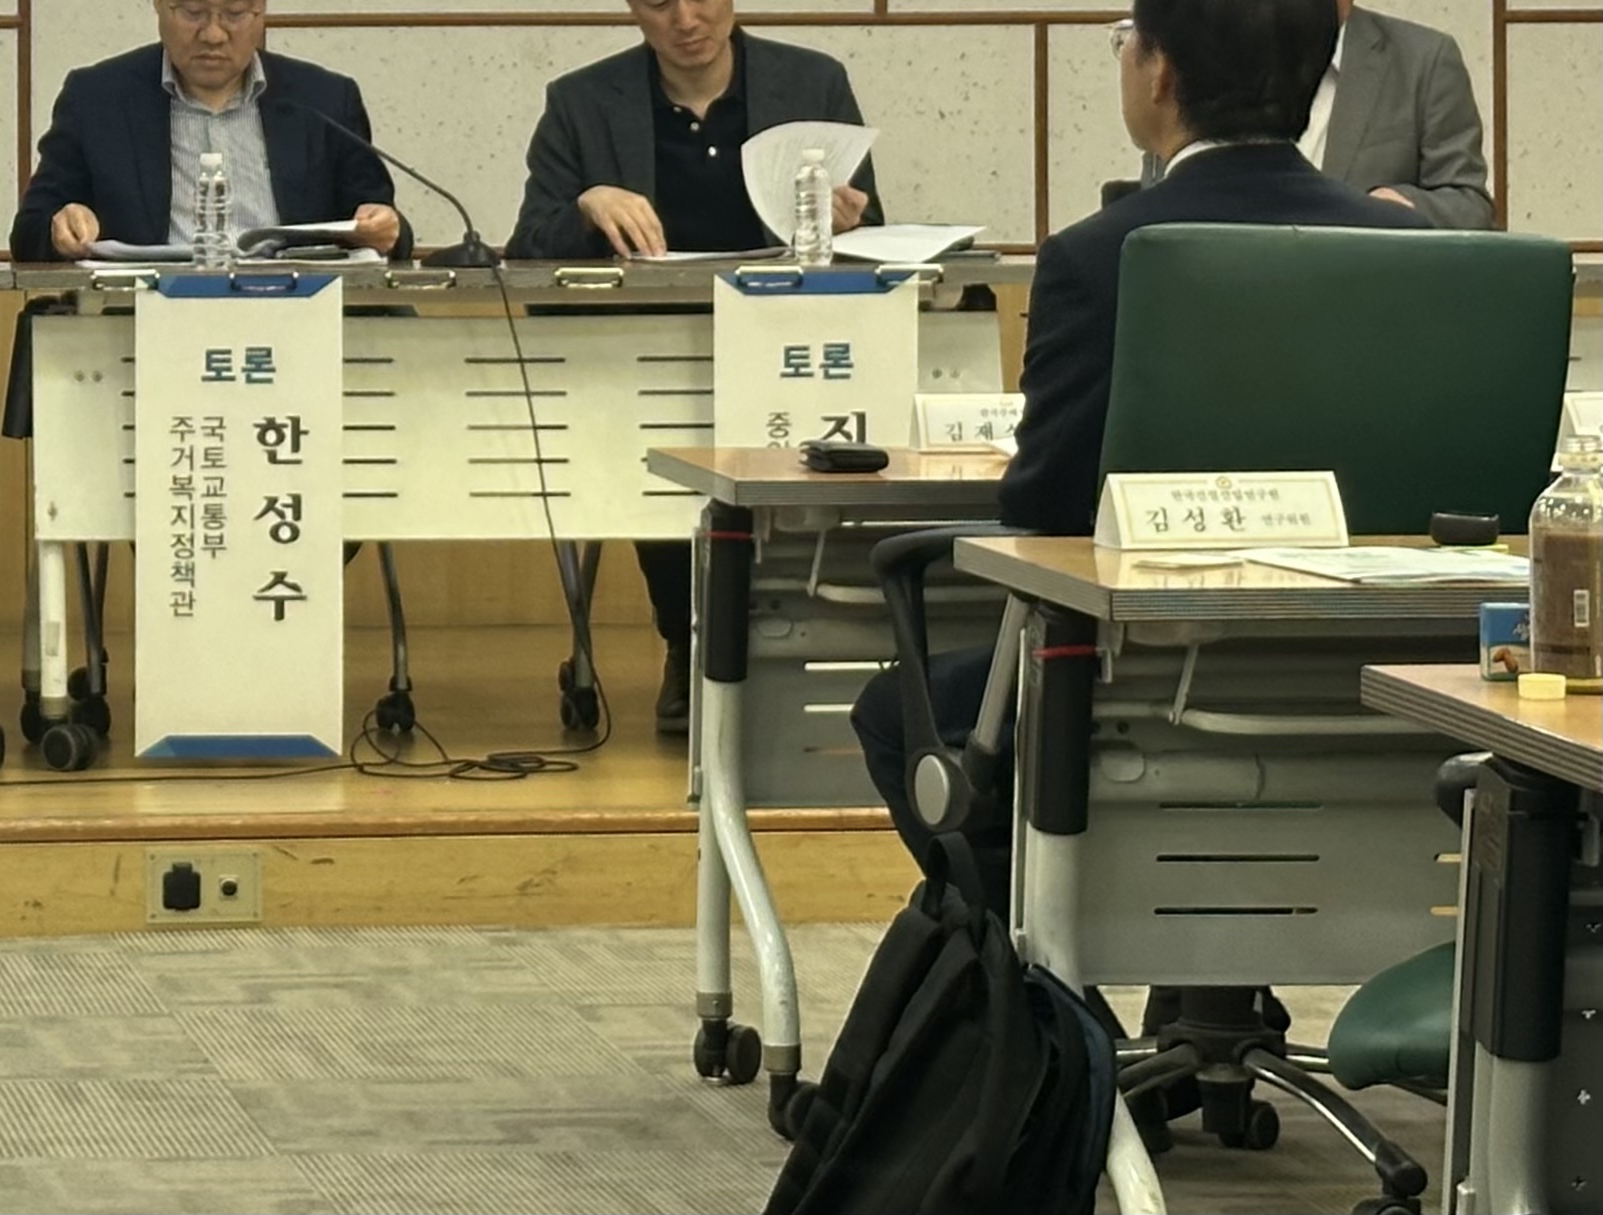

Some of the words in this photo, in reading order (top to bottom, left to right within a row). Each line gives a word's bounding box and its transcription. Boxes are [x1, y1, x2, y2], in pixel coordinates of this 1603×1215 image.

[201, 346, 277, 385] 토론
[780, 343, 854, 380] 토론
[167, 415, 197, 619] 주거복지정책관
[199, 415, 229, 561] 국토교통부
[253, 416, 310, 622] 한성수
[1145, 505, 1247, 534] 김성환
